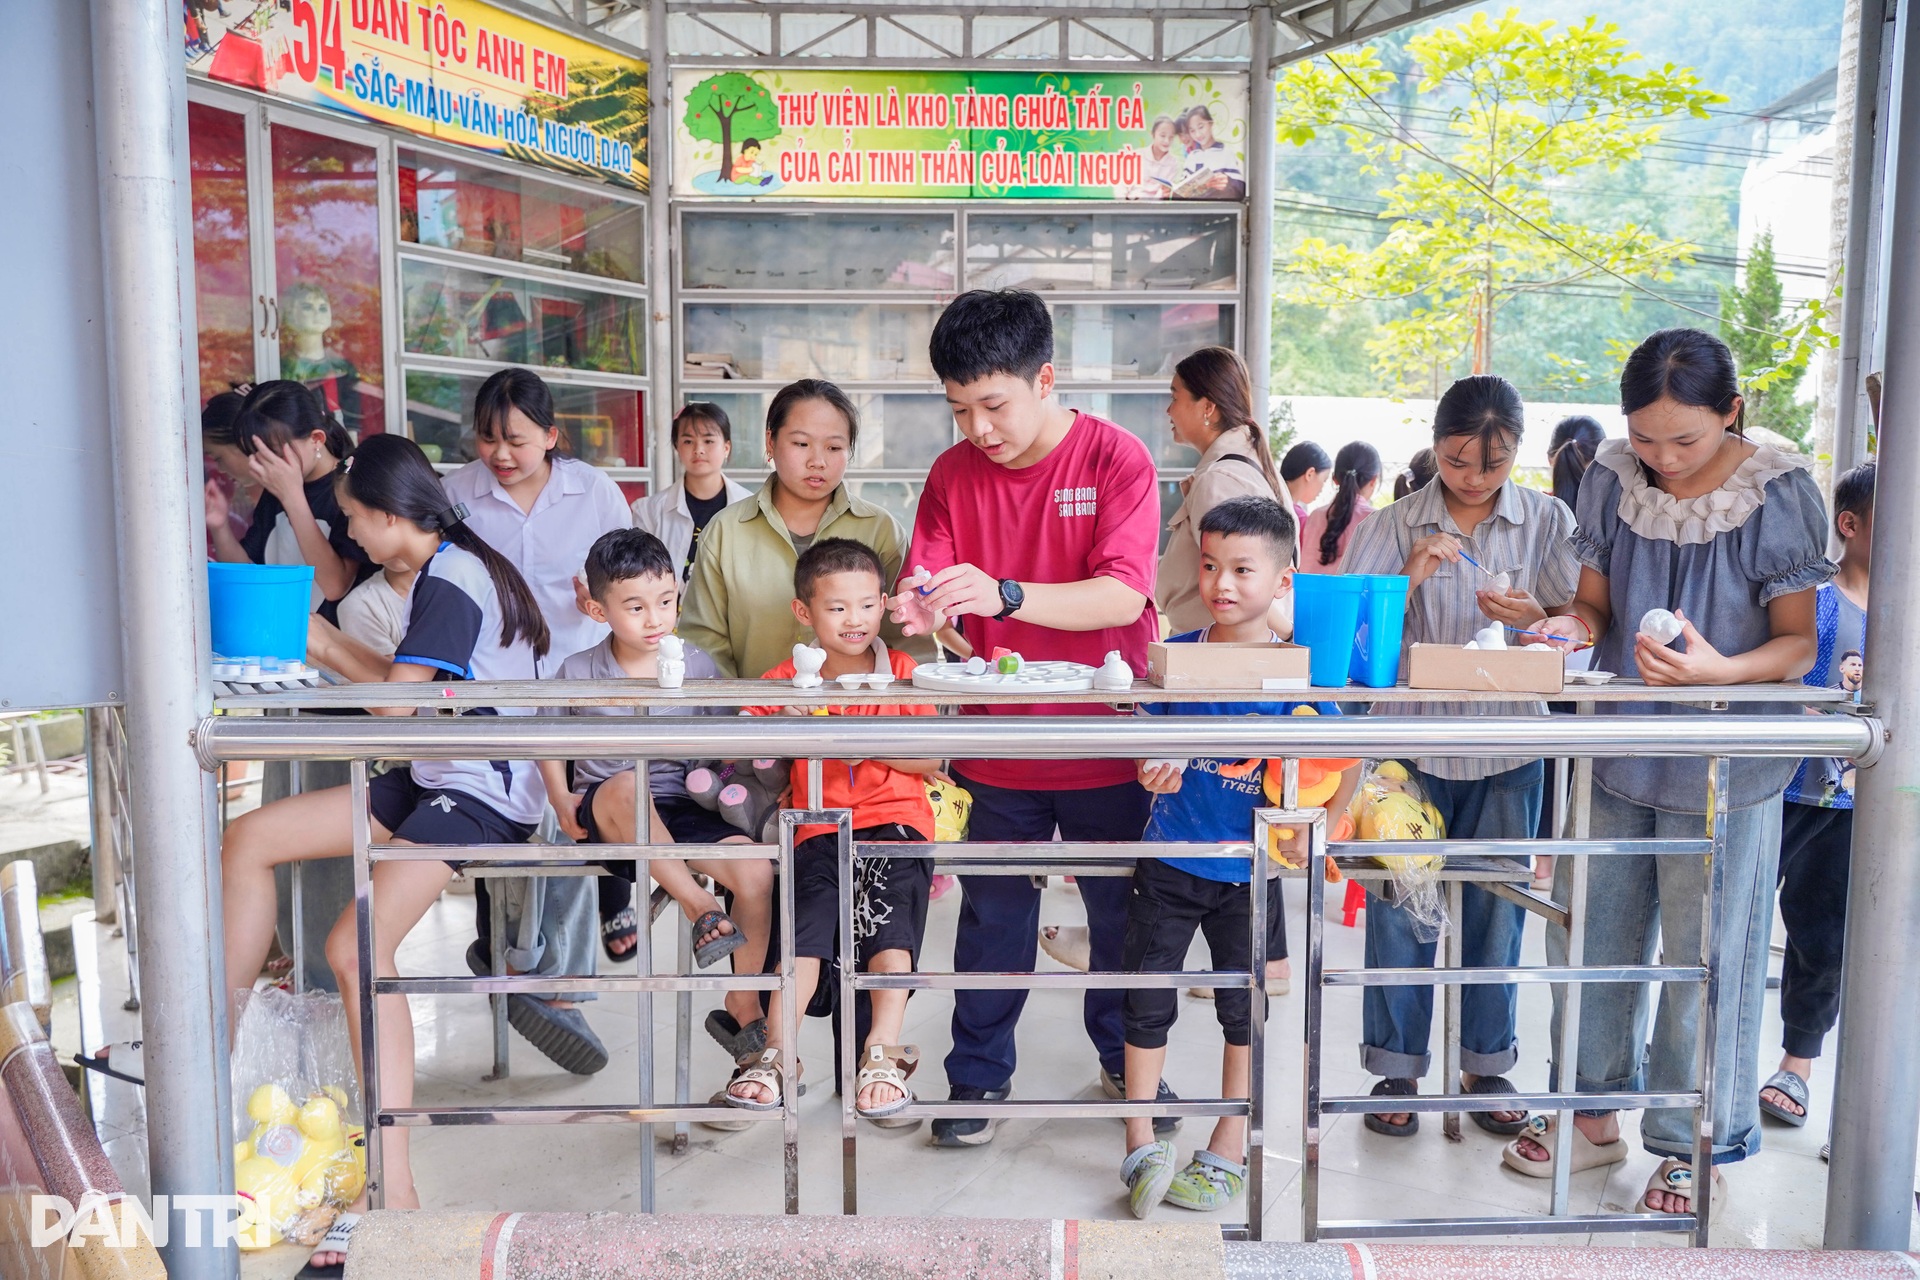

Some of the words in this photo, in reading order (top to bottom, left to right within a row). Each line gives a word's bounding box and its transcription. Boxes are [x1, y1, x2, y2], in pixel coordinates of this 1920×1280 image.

[293, 0, 345, 90] 54
[418, 4, 467, 67] TỘC
[477, 28, 525, 84] ANH
[533, 48, 567, 97] EM
[354, 56, 398, 108] SẮC
[406, 78, 452, 124] MÀU
[458, 91, 497, 137] VĂN
[504, 106, 540, 149] HÓA
[545, 121, 597, 165] NGƯỜI
[601, 137, 632, 174] DAO
[778, 91, 818, 127] THƯ
[823, 88, 868, 134] VIỆN
[876, 89, 900, 127] LÀ
[907, 95, 948, 127] KHO
[954, 88, 1008, 128] TÀNG
[1014, 86, 1070, 128] CHỨA
[1075, 84, 1111, 129] TẤT
[1117, 83, 1145, 129] CẢ
[780, 137, 821, 183] CỦA
[828, 137, 861, 183] CẢI
[869, 151, 914, 183] TINH
[921, 141, 974, 184] THẦN
[981, 139, 1022, 184] CỦA
[1026, 146, 1073, 185] LOÀI
[1080, 146, 1142, 185] NGƯỜI
[1054, 488, 1074, 502] SING
[1075, 487, 1096, 502] BANG
[1059, 503, 1074, 517] SAN
[1075, 502, 1096, 516] BANG
[1188, 758, 1262, 783] OKOMA
[1222, 779, 1261, 795] TYRES
